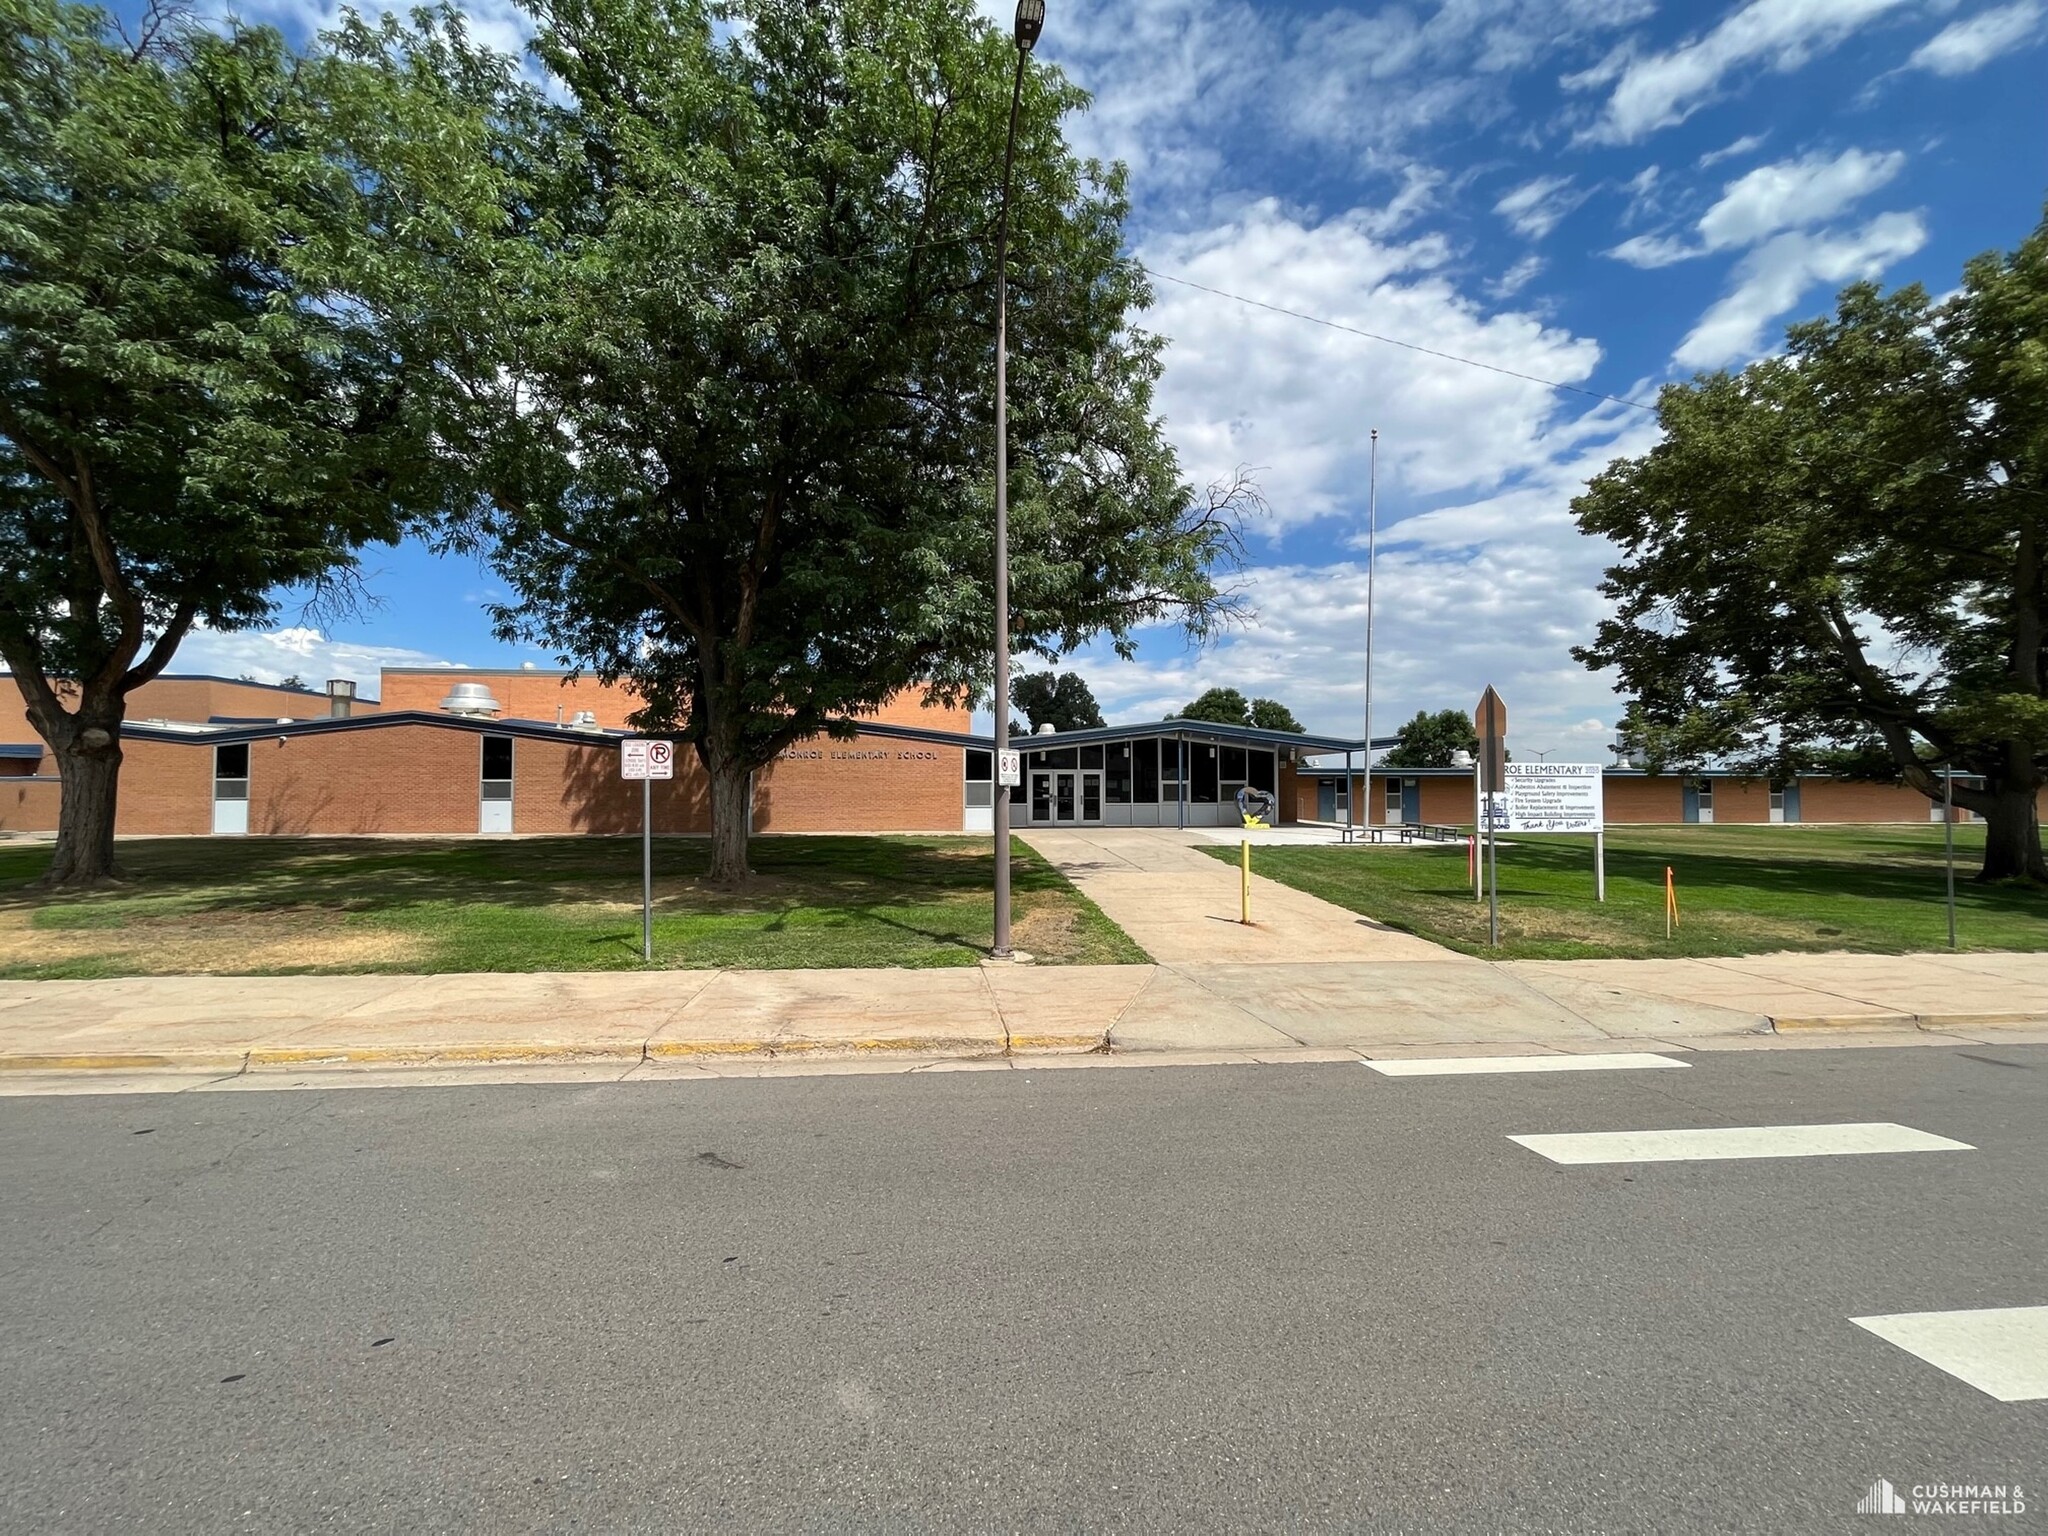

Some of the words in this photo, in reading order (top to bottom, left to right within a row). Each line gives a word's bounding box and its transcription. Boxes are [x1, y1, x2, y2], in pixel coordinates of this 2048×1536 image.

[831, 751, 890, 760] ELEMENTARY
[897, 751, 937, 760] SCHOOL
[1504, 765, 1522, 775] ROE
[1525, 765, 1583, 775] ELEMENTARY
[1520, 820, 1544, 830] Thank
[1546, 819, 1563, 830] You
